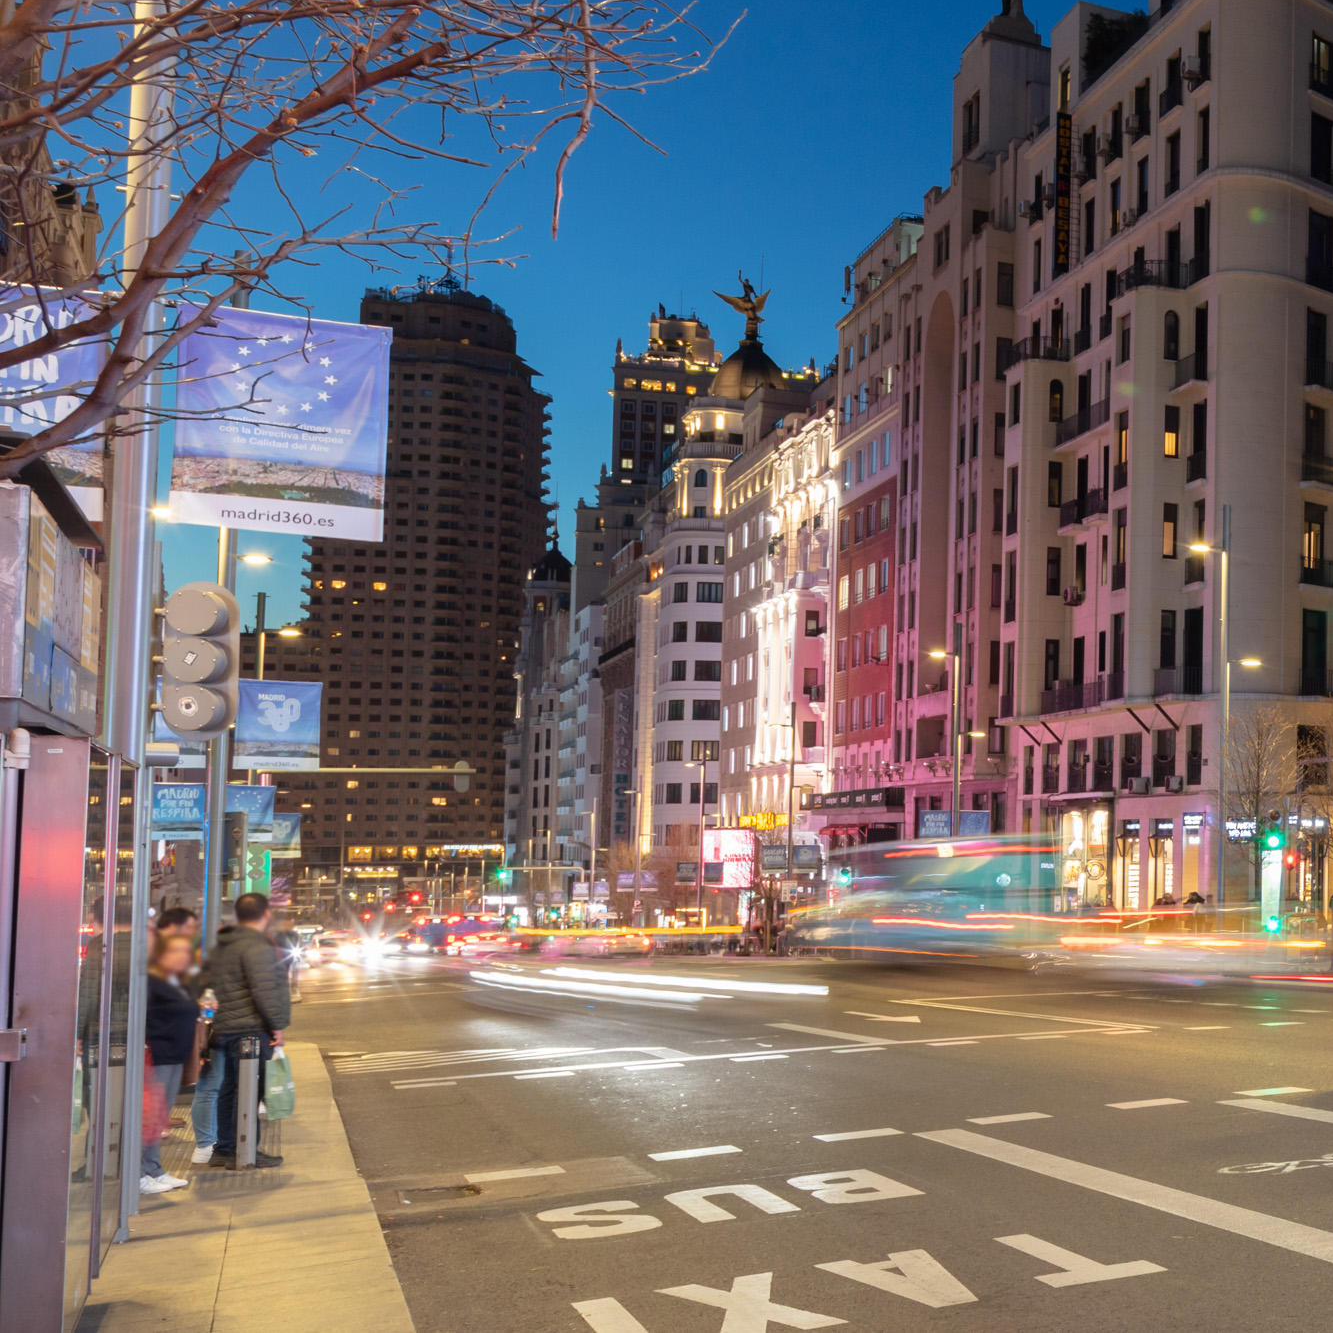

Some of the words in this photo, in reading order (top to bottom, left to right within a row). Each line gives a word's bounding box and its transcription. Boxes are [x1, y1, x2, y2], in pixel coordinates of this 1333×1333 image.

[219, 424, 239, 434] con
[241, 425, 251, 435] la
[253, 427, 299, 440] Directiva
[301, 432, 345, 444] Europea
[233, 436, 247, 444] de
[249, 437, 289, 450] Calidad
[291, 441, 308, 451] del
[310, 443, 329, 453] Aire
[221, 508, 335, 528] madrid360.es
[258, 693, 286, 702] MADRID
[157, 787, 200, 799] MADRID
[152, 807, 200, 819] RESPIRA
[614, 773, 629, 835] HOTEL
[535, 1169, 926, 1241] BUS
